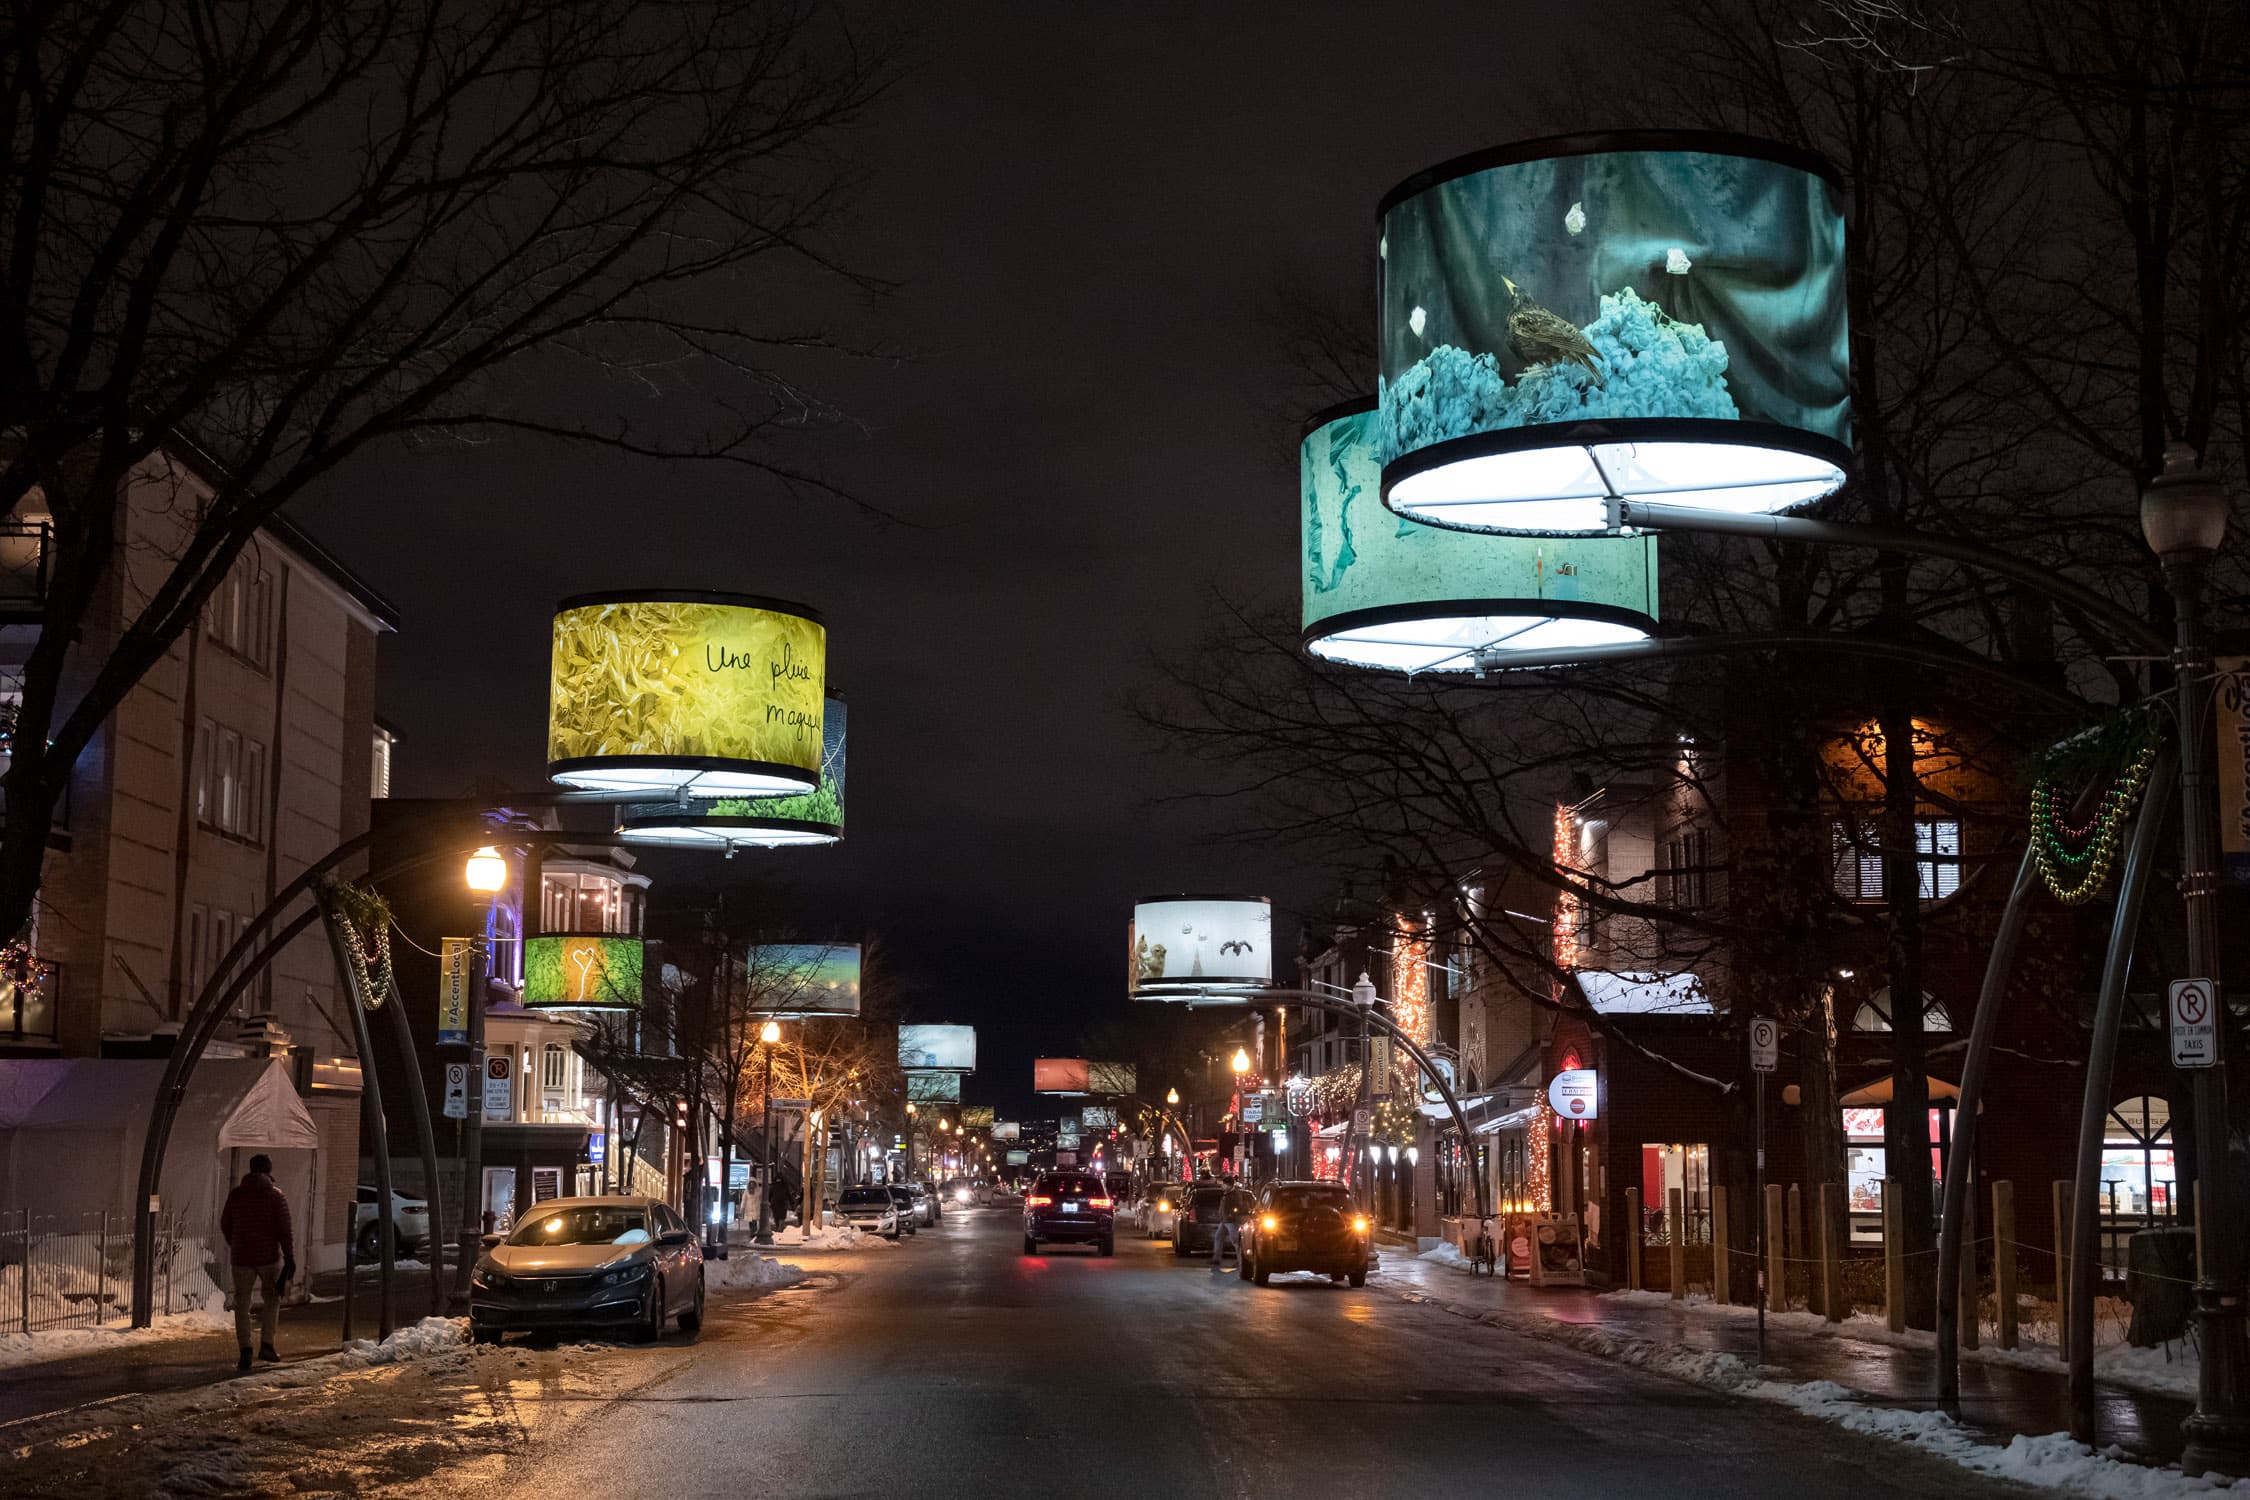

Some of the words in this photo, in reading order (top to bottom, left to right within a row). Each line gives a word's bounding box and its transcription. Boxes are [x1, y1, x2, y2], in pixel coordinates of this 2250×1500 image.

[706, 644, 751, 673] Une
[771, 642, 810, 691] pluie
[448, 943, 461, 1025] #AccentLocal
[2183, 1039, 2204, 1050] TAXIS
